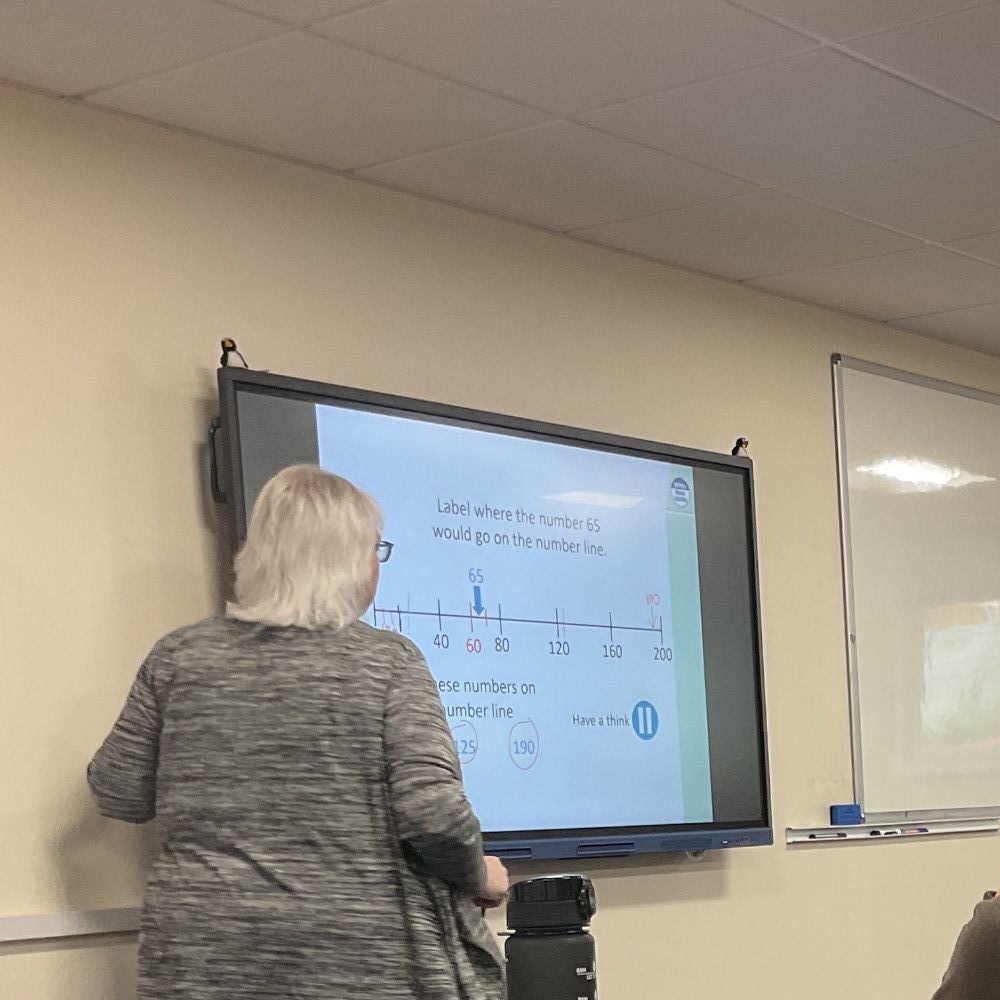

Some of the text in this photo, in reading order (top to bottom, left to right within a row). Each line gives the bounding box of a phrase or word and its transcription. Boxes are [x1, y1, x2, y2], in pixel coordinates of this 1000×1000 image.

[437, 499, 601, 533] Label where the number 65
[432, 526, 607, 557] would go on the number line.
[468, 568, 484, 584] 65
[433, 634, 673, 662] 40 60 80 120 160 200
[464, 678, 517, 695] numbers
[521, 682, 536, 695] on
[491, 703, 514, 719] line
[572, 714, 630, 728] Have a think
[513, 740, 535, 755] 190
